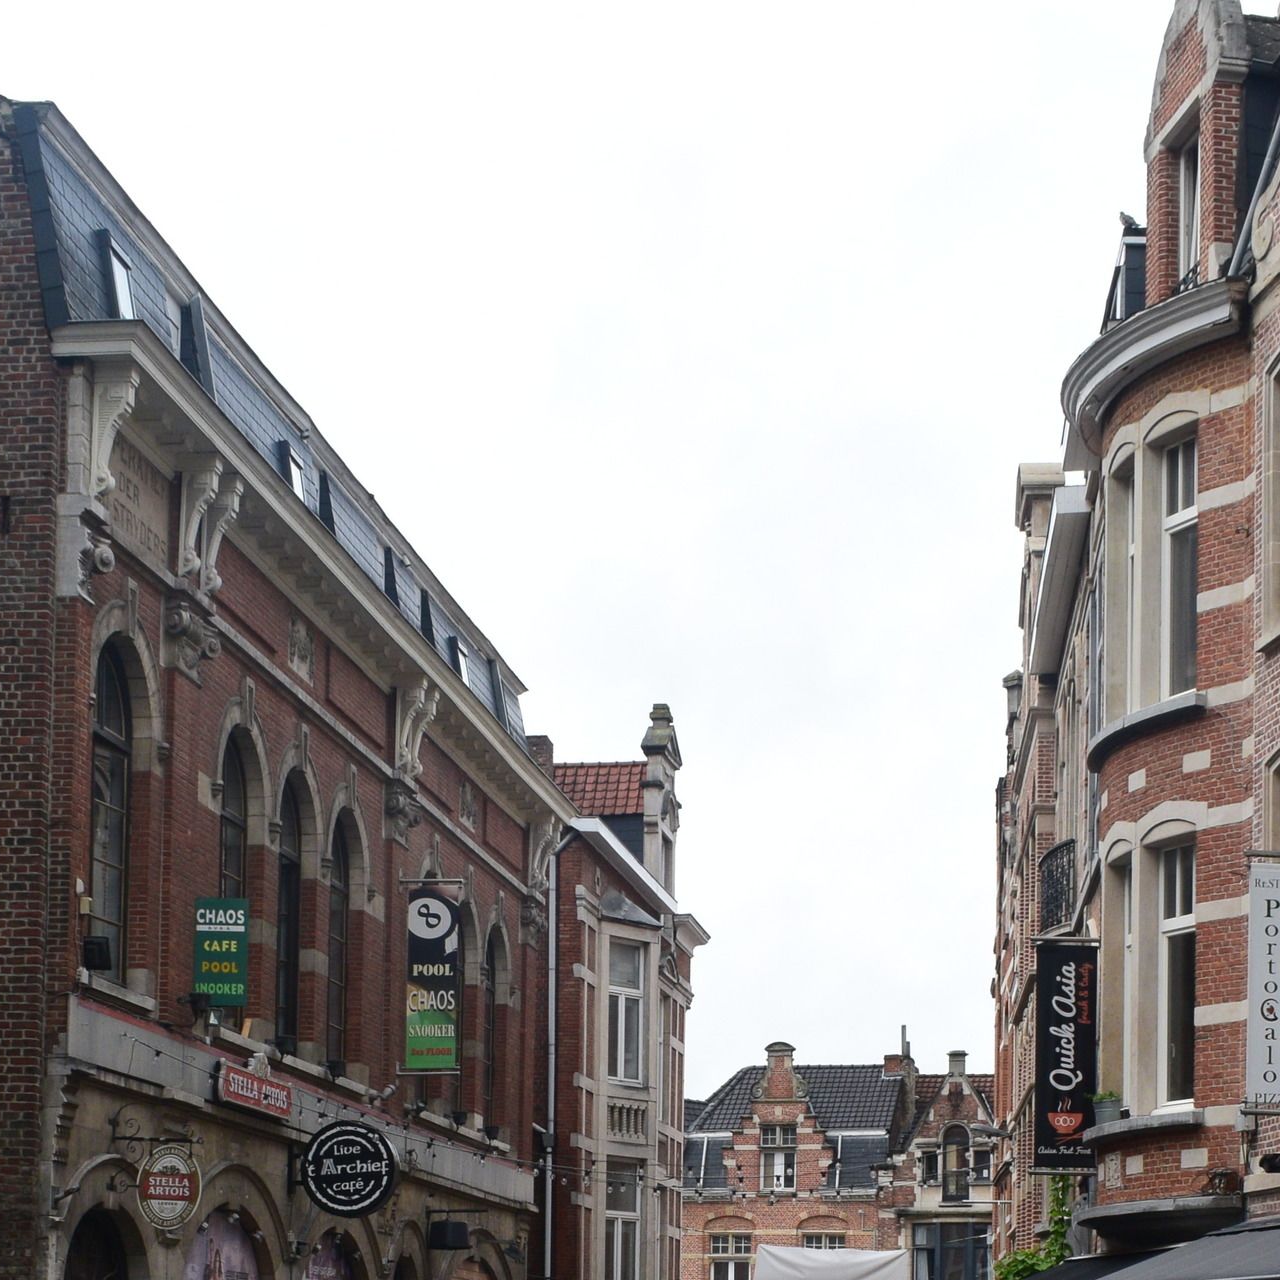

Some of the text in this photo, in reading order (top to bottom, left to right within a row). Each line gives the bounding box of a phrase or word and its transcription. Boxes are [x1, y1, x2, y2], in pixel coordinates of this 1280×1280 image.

[196, 909, 245, 924] CHAOS
[203, 940, 238, 952] CAFE
[201, 961, 238, 973] POOL
[412, 963, 454, 976] POOL
[195, 983, 245, 995] SNOOKER
[409, 990, 456, 1011] CHAOS
[408, 1024, 455, 1037] SNOOKER
[1049, 961, 1082, 1091] Quick Asia
[229, 1073, 288, 1109] STELLA ARTOIS
[333, 1144, 361, 1155] Live
[320, 1158, 389, 1176] Archief
[148, 1176, 189, 1187] STELLA
[333, 1178, 364, 1193] café
[147, 1186, 190, 1197] ARTOIS
